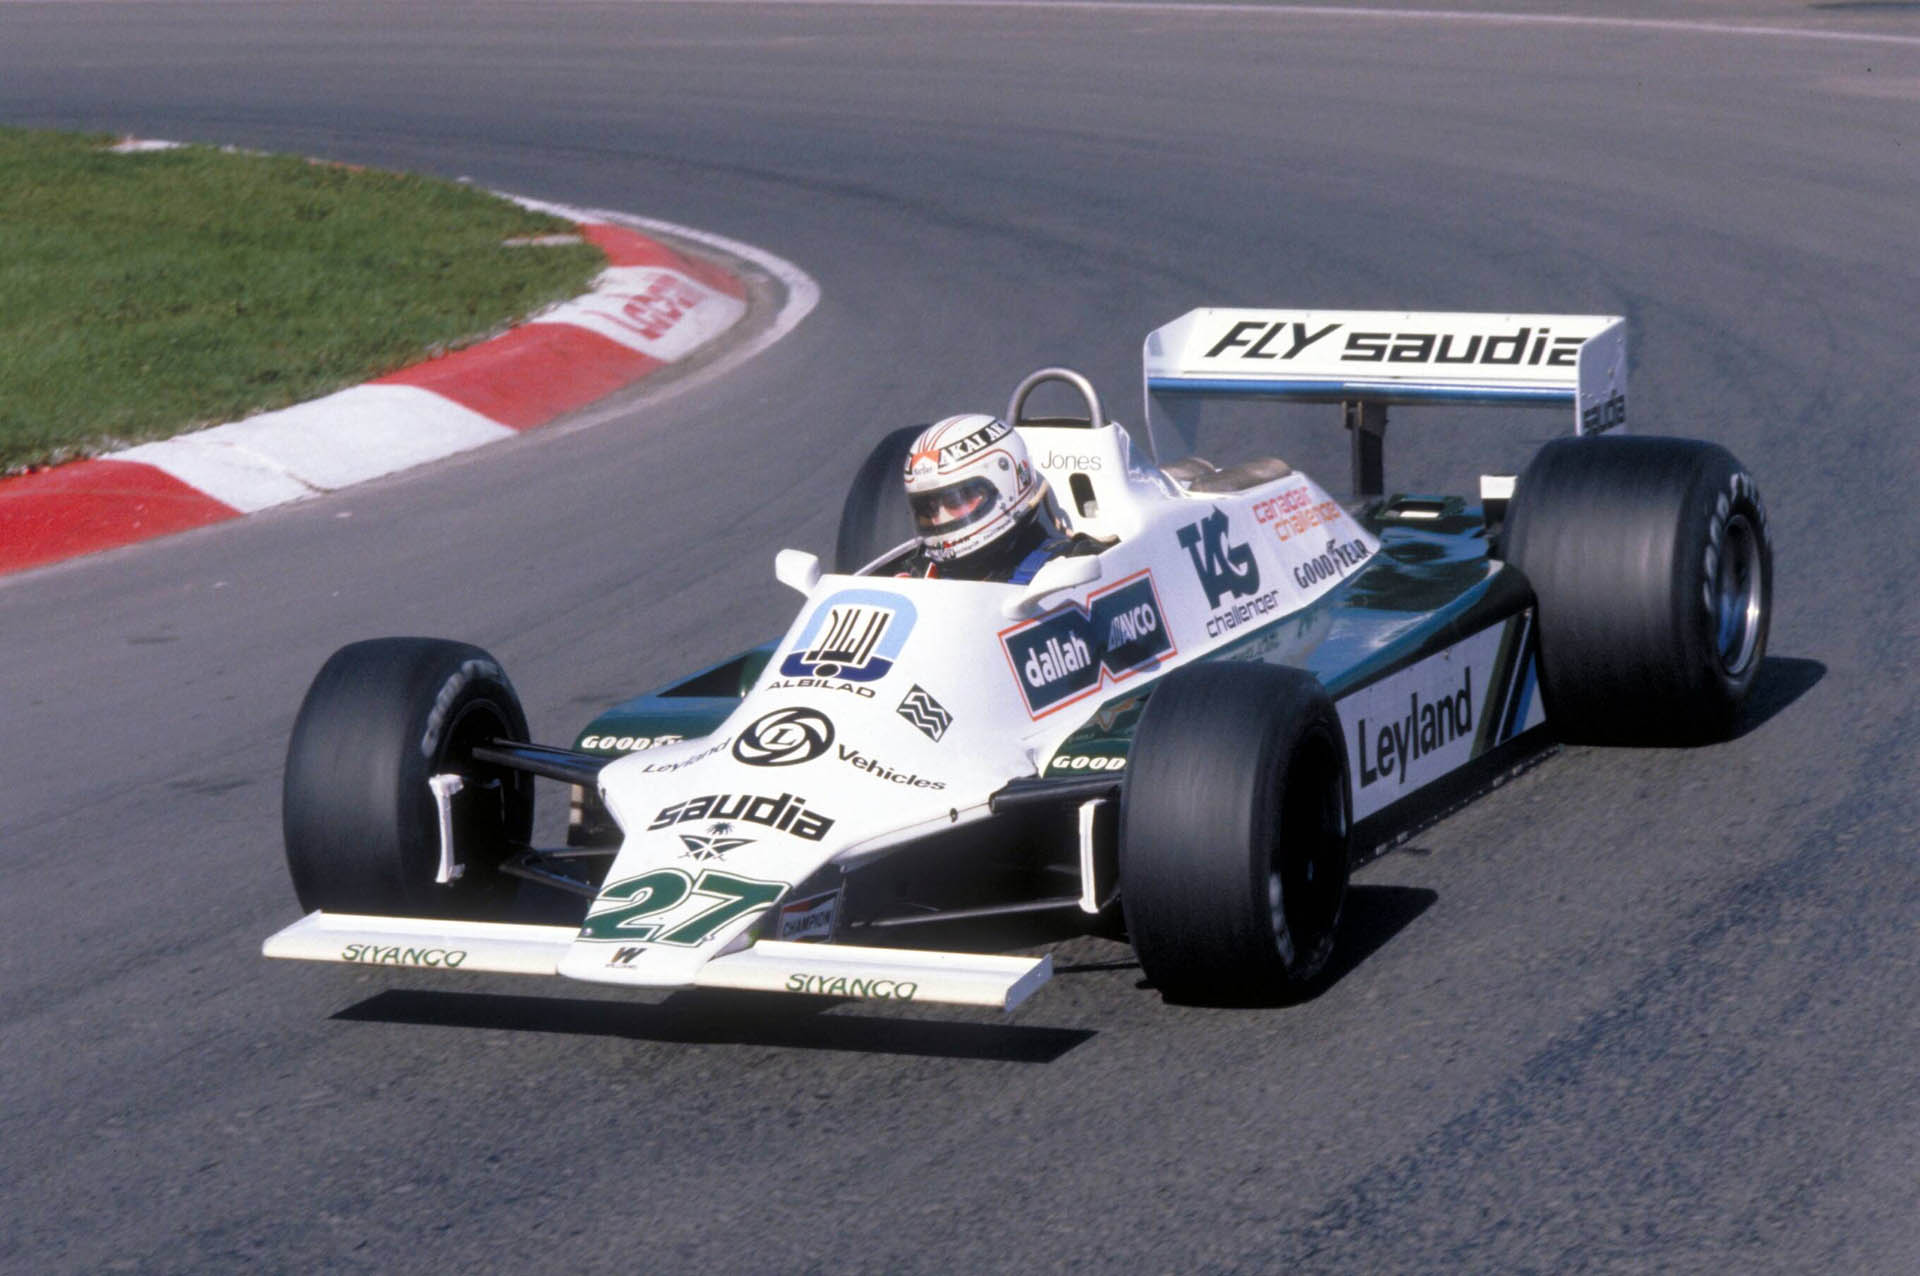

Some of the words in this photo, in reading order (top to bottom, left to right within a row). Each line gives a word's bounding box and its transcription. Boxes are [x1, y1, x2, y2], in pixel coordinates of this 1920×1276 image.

[1204, 321, 1342, 359] FLY
[1341, 327, 1588, 367] saudia
[1041, 450, 1102, 471] Jones
[1176, 504, 1260, 610] TAG
[1206, 590, 1279, 638] challenger
[1025, 630, 1091, 688] dallah
[767, 679, 876, 699] ALBILAD
[1358, 666, 1472, 788] Leyland
[837, 743, 948, 791] Vehicles
[646, 793, 835, 842] saudia
[575, 867, 793, 949] 27
[342, 943, 467, 968] SIYANCO
[785, 973, 918, 1001] SIYANCO
